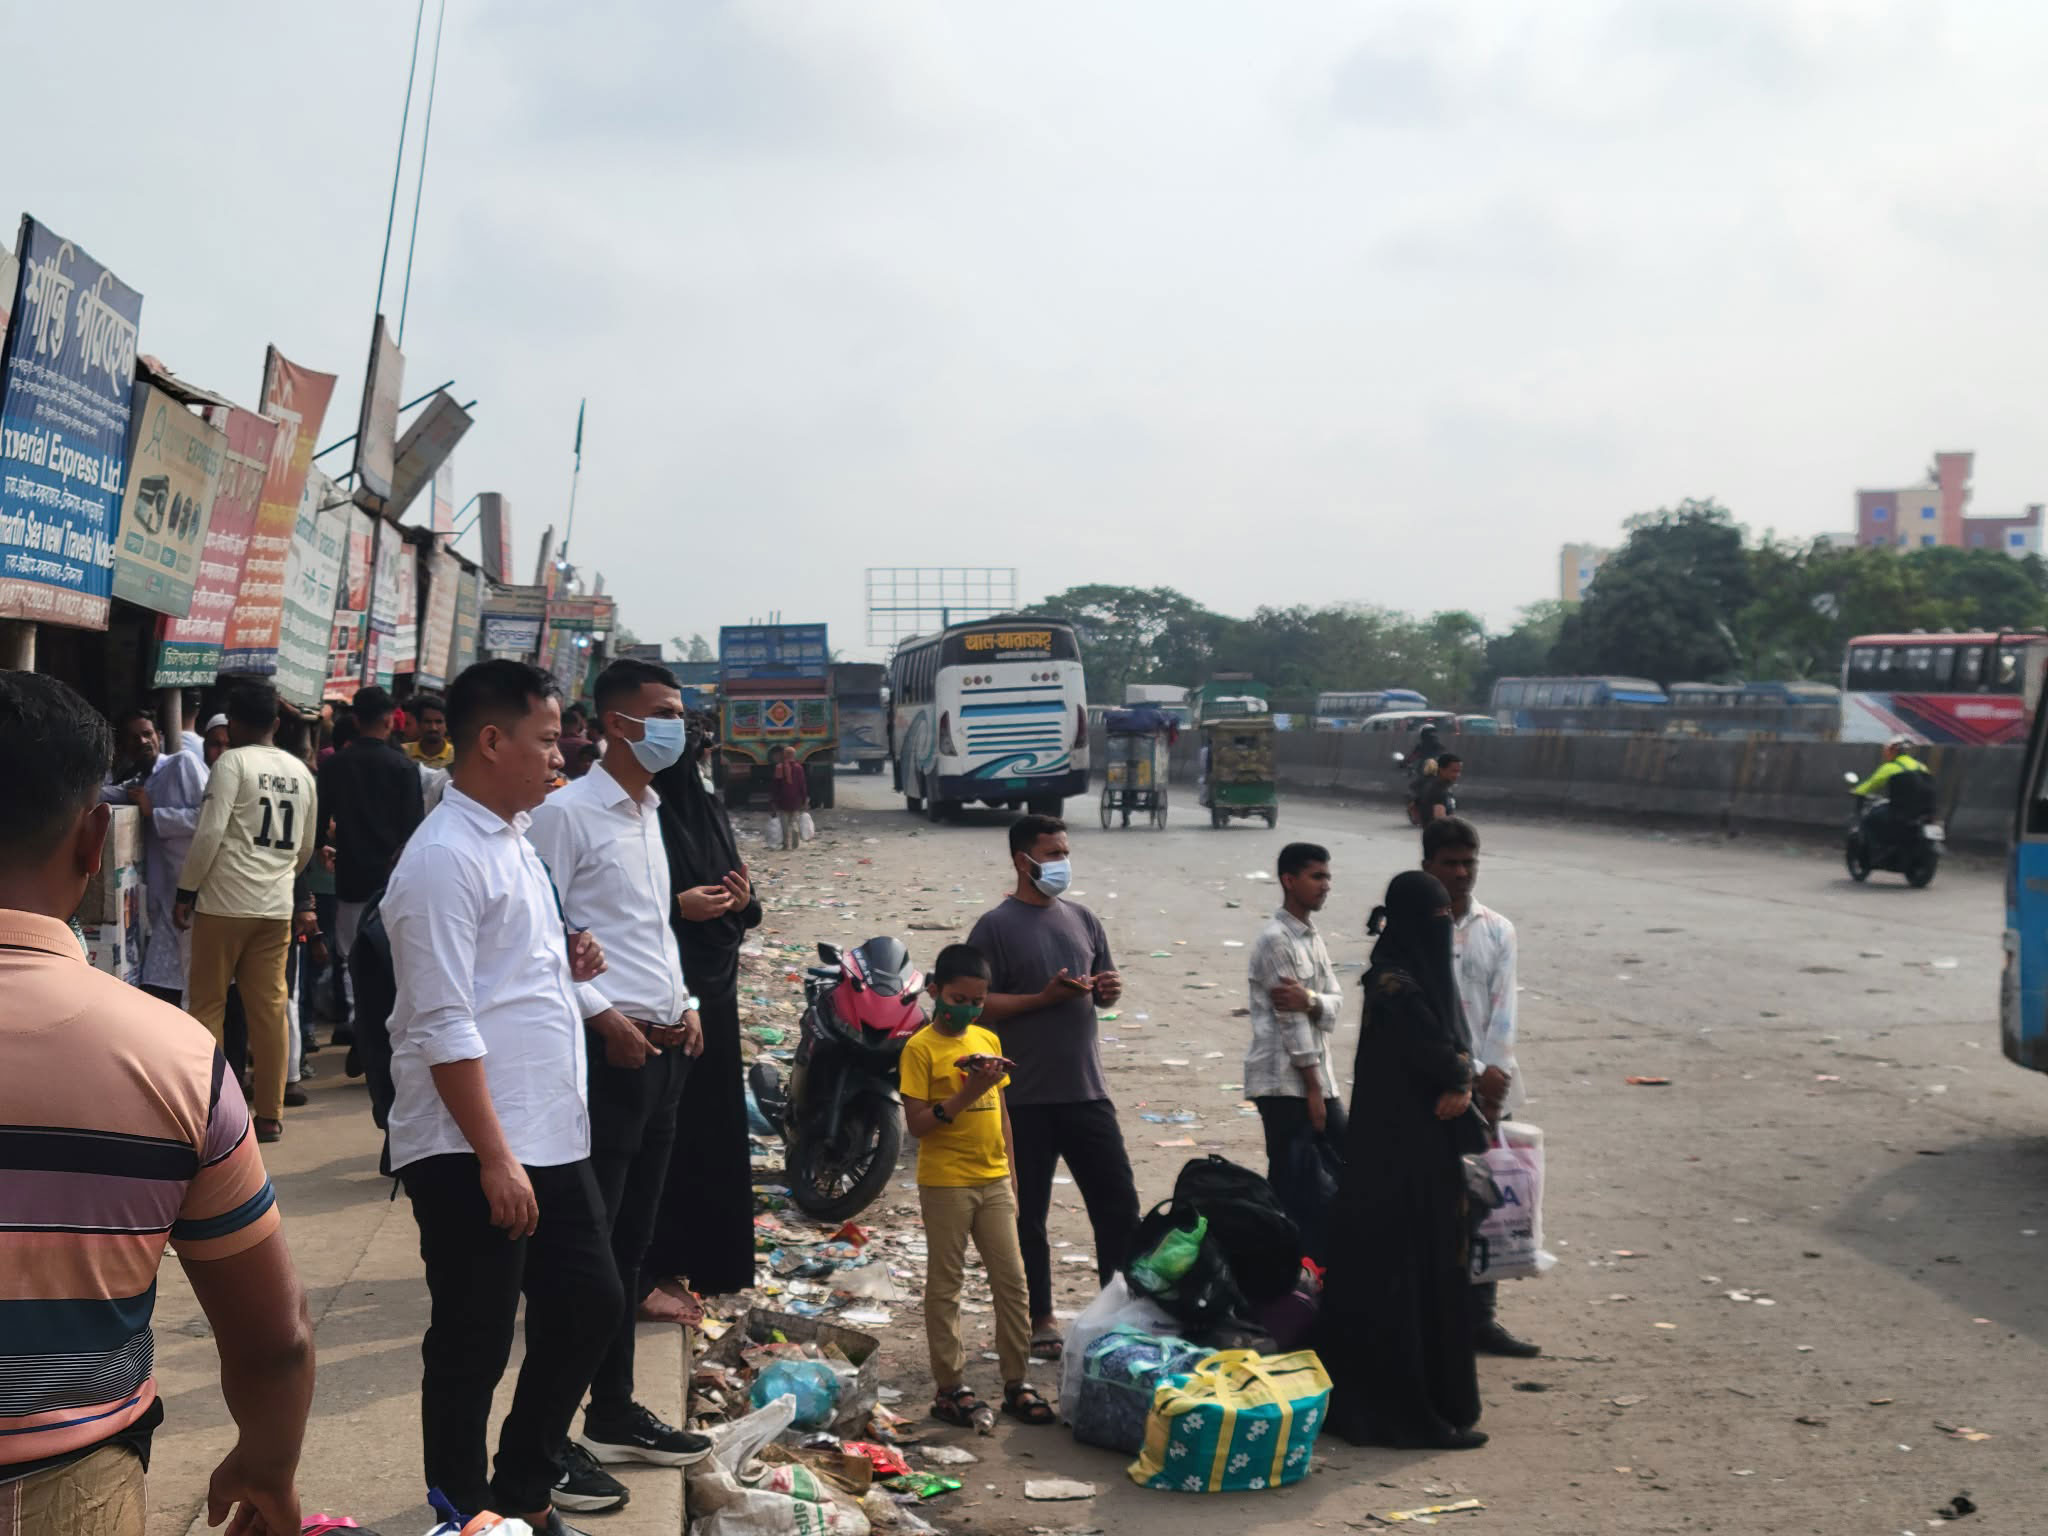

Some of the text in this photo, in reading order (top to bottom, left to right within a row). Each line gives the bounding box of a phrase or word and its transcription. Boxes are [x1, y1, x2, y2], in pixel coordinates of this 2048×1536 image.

[25, 241, 75, 360] শান্তি
[76, 270, 136, 396] পরিবহন
[48, 433, 99, 485] Express
[25, 510, 42, 549] Sea
[253, 797, 294, 850] 11
